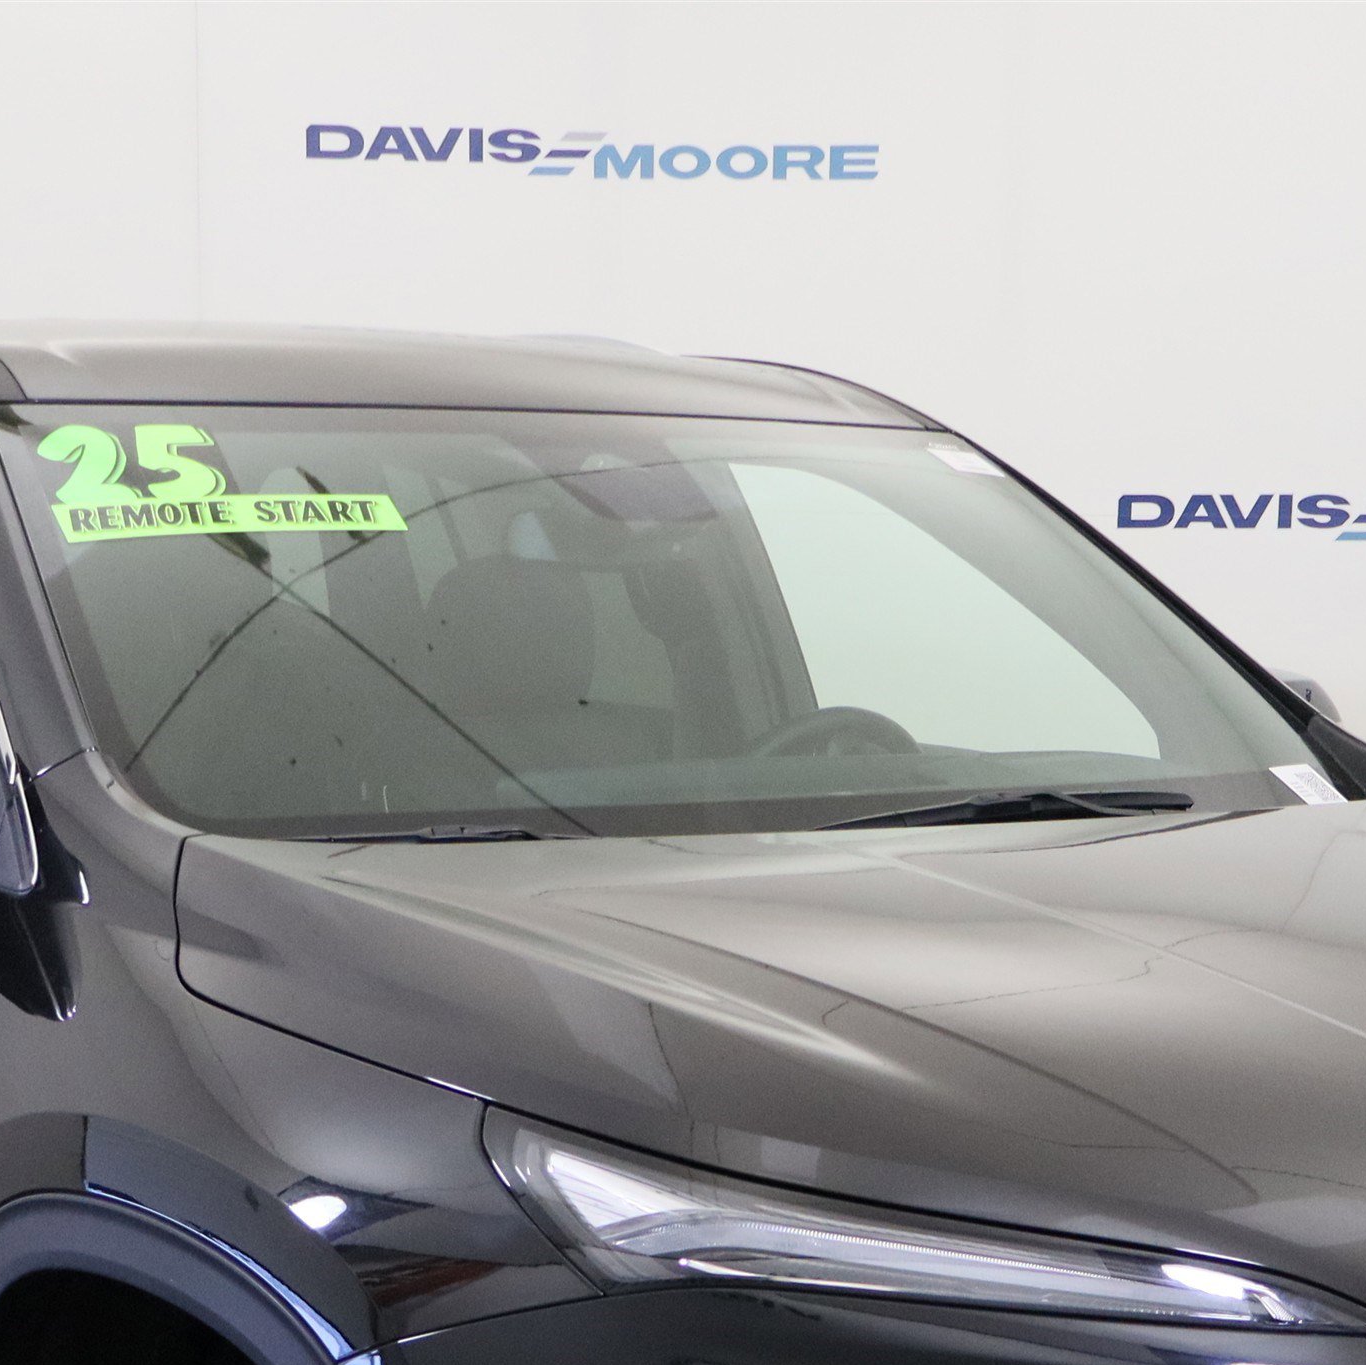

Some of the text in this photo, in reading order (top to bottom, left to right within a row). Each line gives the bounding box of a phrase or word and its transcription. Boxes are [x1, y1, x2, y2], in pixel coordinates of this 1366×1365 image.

[306, 123, 880, 182] DAVIS MOORE
[37, 423, 227, 503] 25
[68, 499, 380, 534] REMOTE START
[1117, 493, 1350, 530] DAVIS
